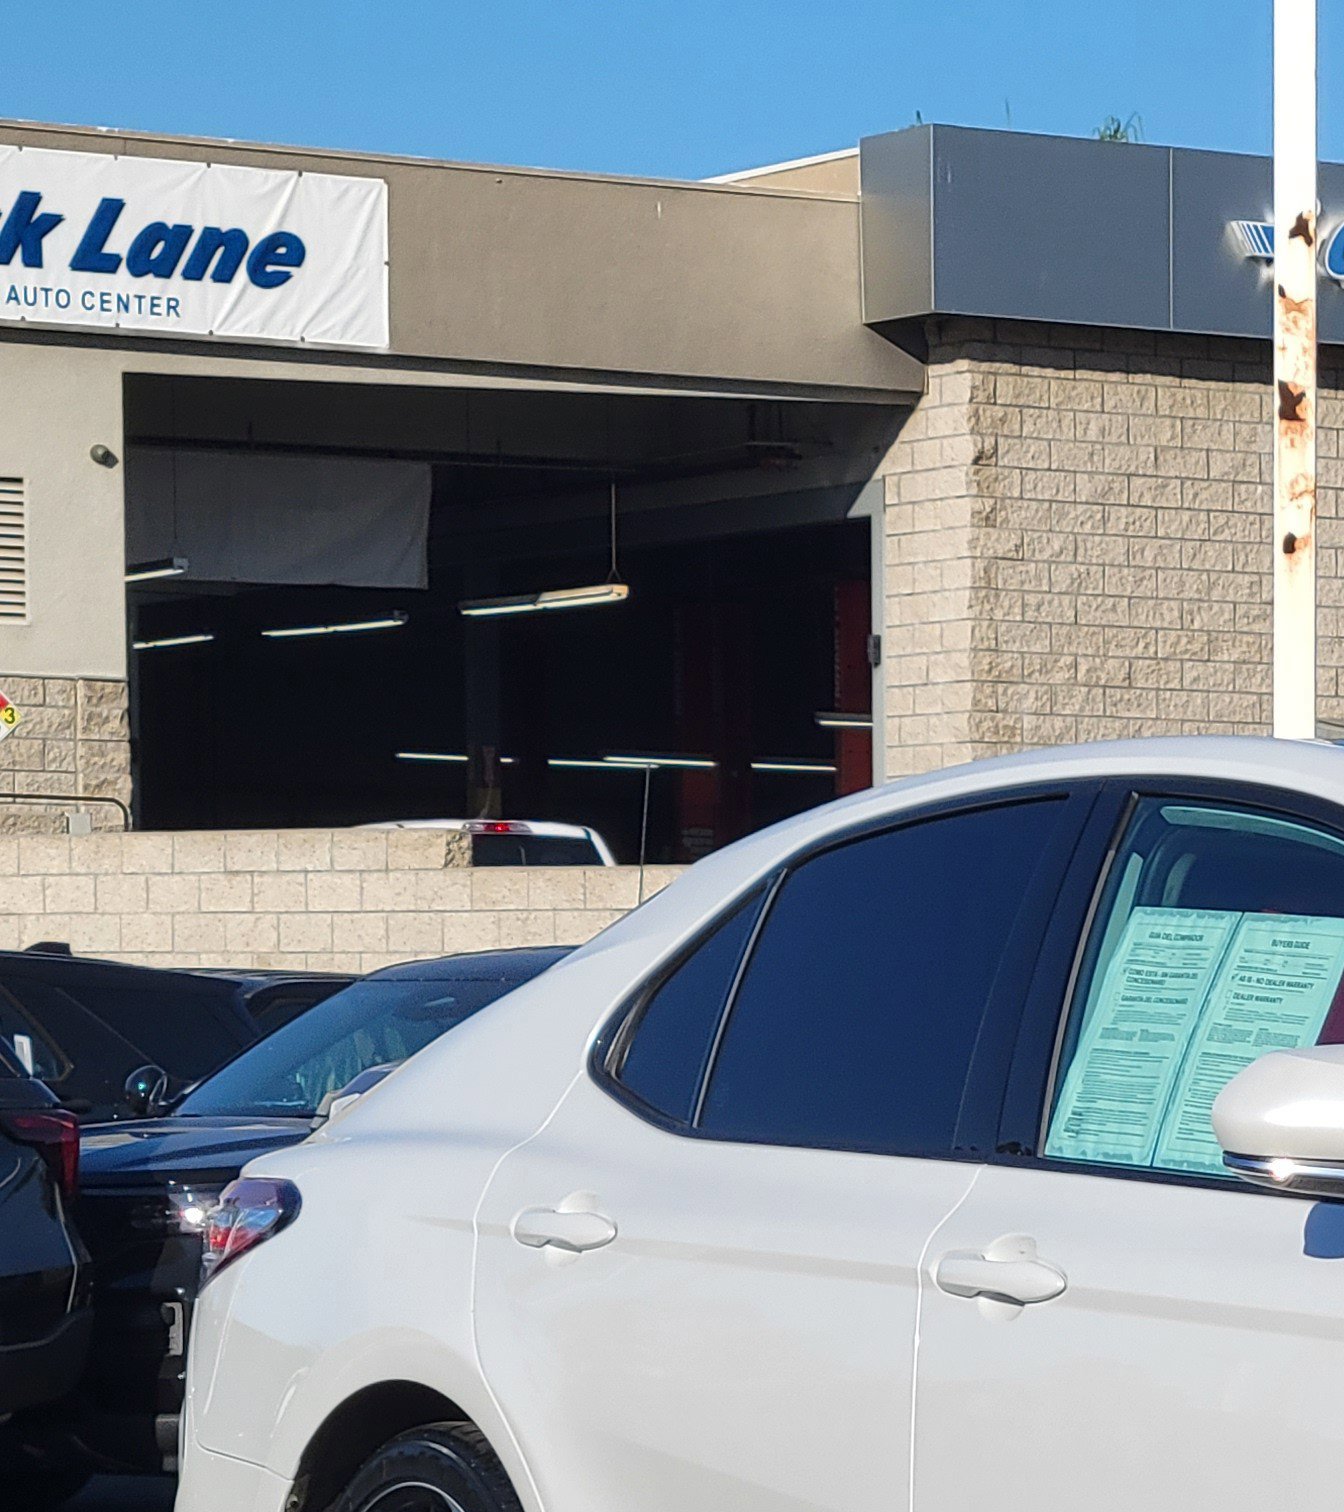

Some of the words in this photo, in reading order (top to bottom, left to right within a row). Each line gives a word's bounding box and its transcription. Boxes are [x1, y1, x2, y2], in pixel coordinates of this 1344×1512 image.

[0, 191, 65, 268] k
[69, 197, 306, 290] Lane
[7, 284, 71, 309] AUTO
[81, 290, 182, 318] CENTER
[4, 707, 15, 724] 3
